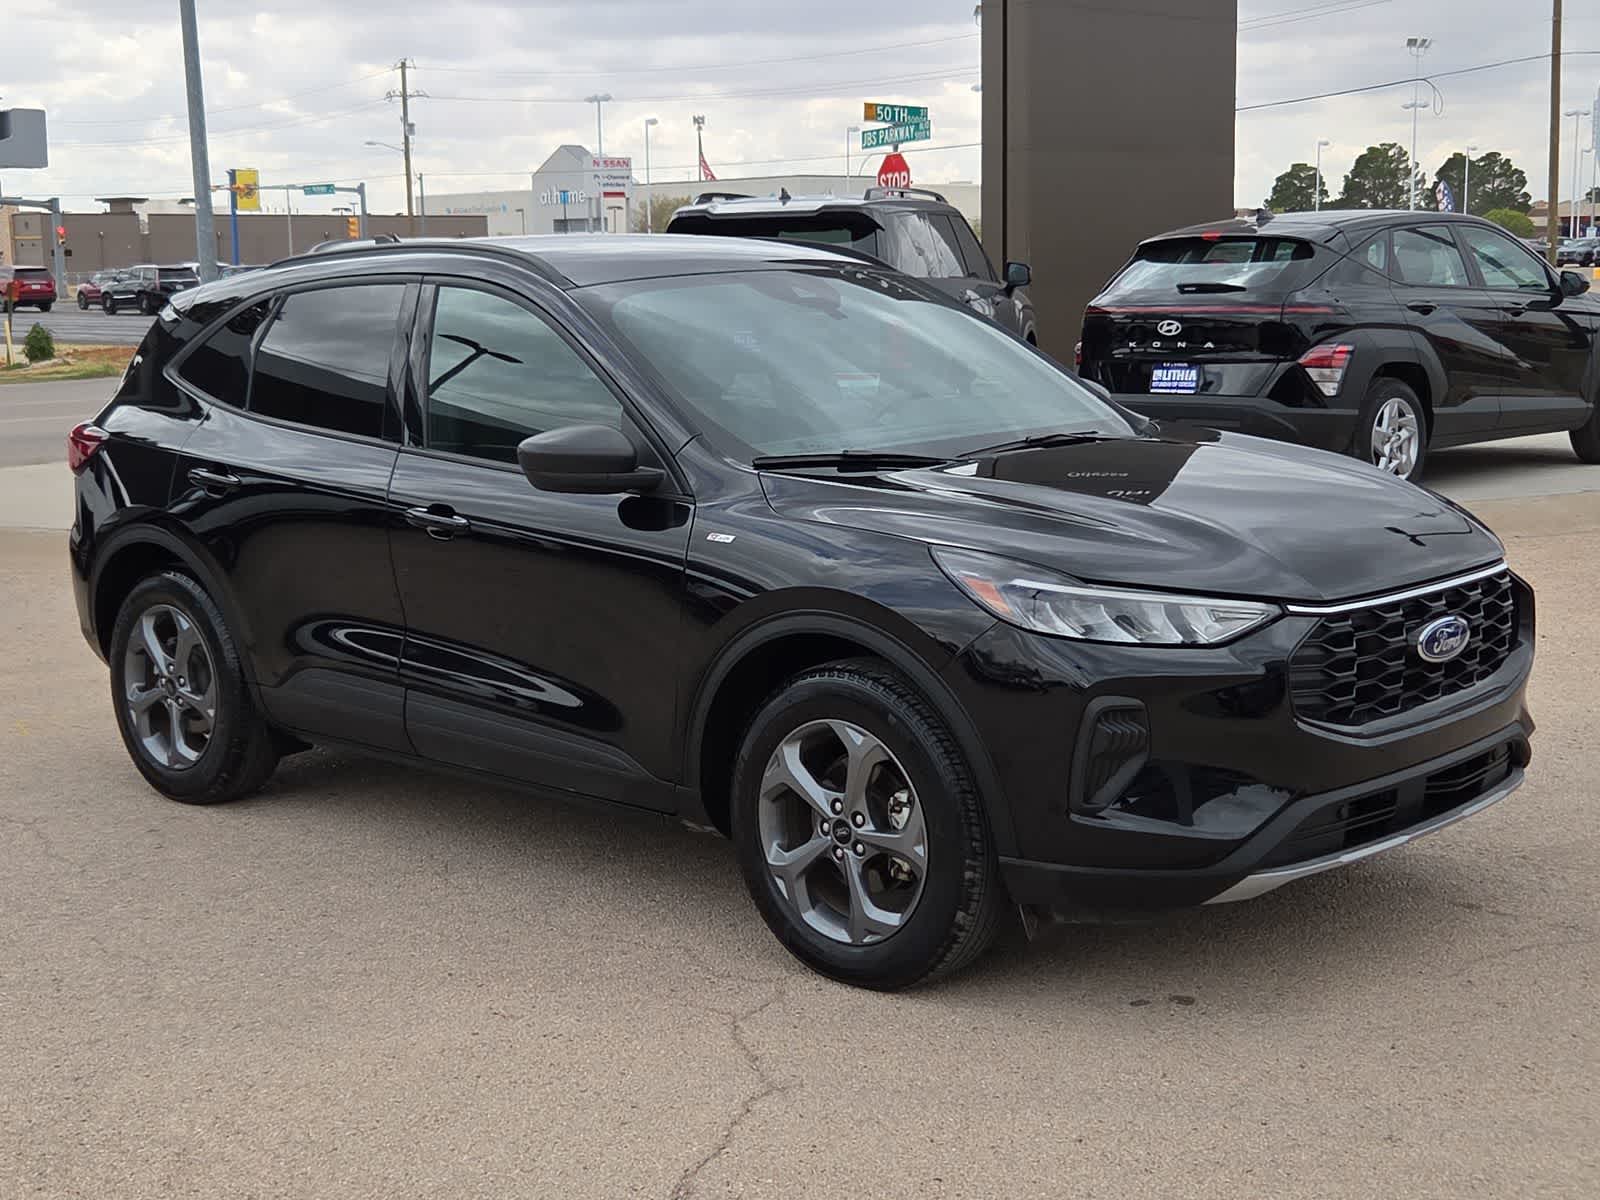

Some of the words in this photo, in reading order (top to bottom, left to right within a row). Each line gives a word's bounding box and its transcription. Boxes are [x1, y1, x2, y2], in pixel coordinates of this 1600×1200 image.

[863, 131, 877, 147] JBS
[879, 124, 916, 144] PARKWAY
[592, 159, 629, 168] NSSAN
[880, 171, 908, 188] STOP
[1161, 369, 1197, 381] LITHIA
